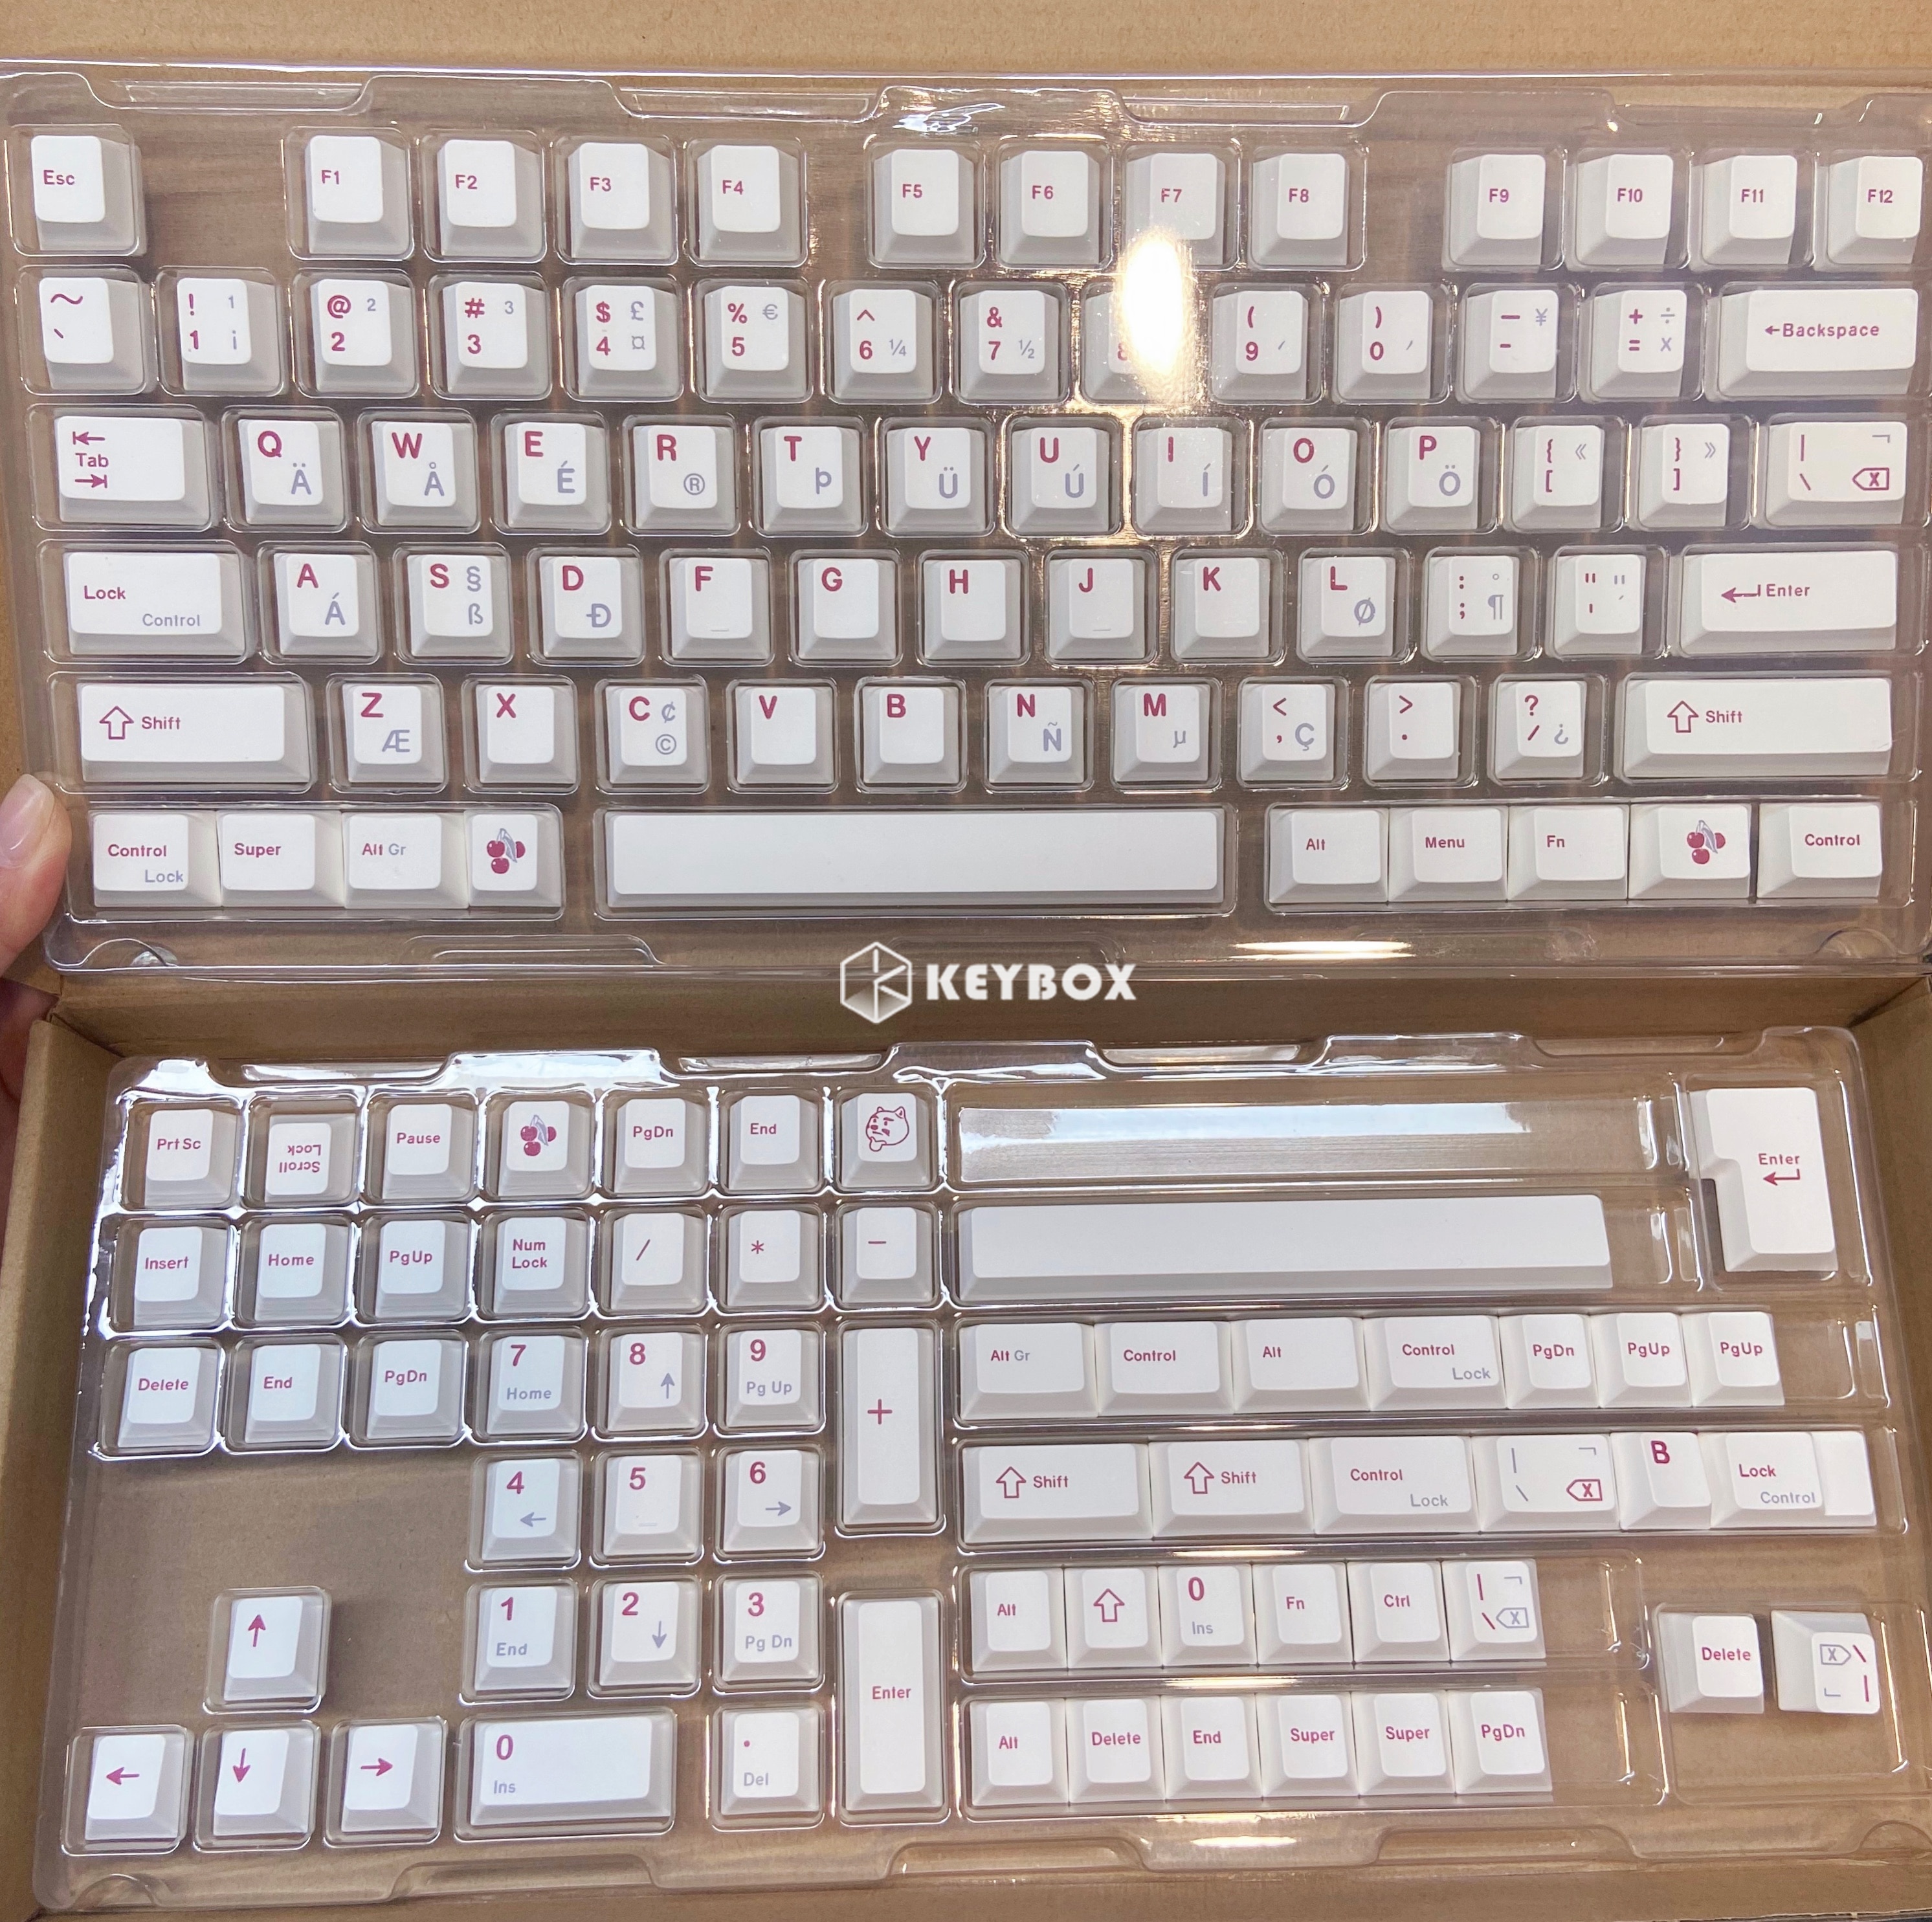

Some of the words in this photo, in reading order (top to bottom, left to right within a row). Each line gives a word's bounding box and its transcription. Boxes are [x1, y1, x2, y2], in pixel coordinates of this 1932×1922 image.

[43, 170, 74, 185] Esc
[322, 170, 339, 184] F1
[456, 175, 477, 189] F2
[590, 177, 611, 192] F3
[723, 180, 743, 195] F4
[903, 184, 922, 198] F5
[1032, 185, 1053, 199] F6
[1161, 188, 1182, 203] F7
[1289, 188, 1309, 203] F8
[1489, 188, 1509, 203] F9
[1617, 188, 1642, 202] F10
[1742, 189, 1763, 203] F11
[1868, 189, 1893, 203] F12
[189, 294, 194, 315] !
[328, 295, 351, 318] @
[465, 298, 484, 318] #
[596, 302, 610, 323] $
[728, 303, 747, 324] %
[987, 307, 1002, 327] &
[190, 331, 199, 349] 1
[331, 332, 345, 351] 2
[468, 335, 481, 354] 3
[596, 337, 610, 355] 4
[732, 337, 744, 356] 5
[860, 340, 872, 359] 6
[988, 341, 1001, 360] 7
[1246, 342, 1258, 361] 9
[1370, 342, 1384, 360] 0
[258, 431, 282, 458] Q
[392, 432, 422, 459] W
[525, 431, 543, 457] E
[657, 434, 676, 461] R
[784, 436, 802, 461] T
[914, 436, 931, 461] Y
[1040, 437, 1059, 463] U
[1293, 438, 1314, 463] O
[1419, 436, 1437, 460] P
[75, 453, 109, 467] Tab
[291, 463, 311, 494] Ä
[425, 462, 445, 496] Å
[557, 461, 575, 493] É
[939, 467, 958, 498] Ü
[1065, 464, 1083, 498] Ú
[1314, 465, 1335, 499] Ó
[1439, 465, 1460, 496] Ö
[297, 564, 318, 588] A
[430, 564, 449, 588] S
[467, 566, 481, 591] §
[562, 566, 583, 591] D
[695, 566, 713, 591] F
[821, 568, 842, 591] G
[949, 569, 968, 594] H
[1079, 568, 1093, 592] J
[1203, 567, 1221, 591] K
[1331, 566, 1348, 590] L
[84, 586, 126, 599] Lock
[1766, 584, 1810, 597] Enter
[325, 592, 346, 625] Á
[1354, 597, 1375, 626] Ø
[142, 613, 199, 626] Control
[361, 692, 383, 718] Z
[496, 693, 516, 718] X
[629, 696, 650, 721] C
[759, 695, 777, 719] V
[887, 694, 905, 718] B
[1017, 694, 1035, 717] N
[1144, 693, 1166, 716] M
[1525, 695, 1538, 716] ?
[142, 716, 180, 729] Shift
[1706, 711, 1742, 723] Shift
[382, 730, 410, 753] Æ
[656, 734, 676, 755] ©
[1043, 722, 1061, 751] Ñ
[1295, 723, 1314, 751] Ç
[1306, 839, 1325, 850] Alt
[1426, 837, 1464, 848] Menu
[1547, 835, 1564, 847] Fn
[1805, 834, 1860, 846] Control
[108, 844, 166, 856] Control
[235, 843, 281, 857] Super
[362, 843, 383, 855] Alt
[388, 843, 406, 855] Gr
[145, 870, 183, 883] Lock
[634, 1126, 673, 1140] PgDn
[751, 1123, 776, 1134] End
[397, 1132, 440, 1143] Pause
[288, 1145, 321, 1156] Lock
[1759, 1153, 1799, 1165] Enter
[280, 1162, 320, 1173] Scroll
[513, 1239, 545, 1251] Num
[146, 1257, 188, 1269] Insert
[269, 1254, 314, 1266] Home
[390, 1251, 432, 1265] PgUp
[513, 1257, 547, 1268] Lock
[511, 1345, 526, 1366] 7
[630, 1343, 645, 1365] 8
[750, 1340, 766, 1362] 9
[991, 1350, 1009, 1361] Alt
[1014, 1350, 1030, 1361] Gr
[1124, 1350, 1175, 1361] Control
[1263, 1347, 1281, 1358] Alt
[1403, 1344, 1454, 1355] Control
[1533, 1344, 1574, 1359] PgDn
[1628, 1342, 1669, 1358] PgUp
[1720, 1342, 1762, 1357] PgUp
[385, 1370, 427, 1386] PgDn
[1452, 1367, 1491, 1380] Lock
[139, 1378, 188, 1391] Delete
[264, 1376, 292, 1389] End
[507, 1387, 551, 1400] Home
[1651, 1441, 1670, 1464] B
[630, 1467, 645, 1490] 5
[750, 1462, 766, 1484] 6
[1221, 1472, 1256, 1484] Shift
[1351, 1469, 1403, 1481] Control
[1739, 1464, 1776, 1477] Lock
[507, 1472, 524, 1494] 4
[1034, 1475, 1068, 1488] Shift
[1410, 1494, 1448, 1507] Lock
[1760, 1492, 1815, 1503] Control
[1188, 1577, 1204, 1600] 0
[501, 1597, 513, 1620] 1
[622, 1592, 638, 1615] 2
[748, 1593, 764, 1617] 3
[1287, 1596, 1304, 1609] Fn
[1384, 1595, 1410, 1607] Ctrl
[997, 1604, 1016, 1616] Alt
[1192, 1622, 1213, 1634] Ins
[496, 1642, 527, 1656] End
[1702, 1647, 1750, 1661] Delete
[872, 1686, 911, 1699] Enter
[1092, 1732, 1140, 1745] Delete
[1194, 1730, 1221, 1744] End
[1291, 1729, 1335, 1743] Super
[1386, 1727, 1429, 1742] Super
[1482, 1724, 1525, 1741] PgDn
[496, 1735, 513, 1760] 0
[999, 1736, 1017, 1749] Alt
[494, 1780, 516, 1794] Ins
[744, 1773, 768, 1786] Del
